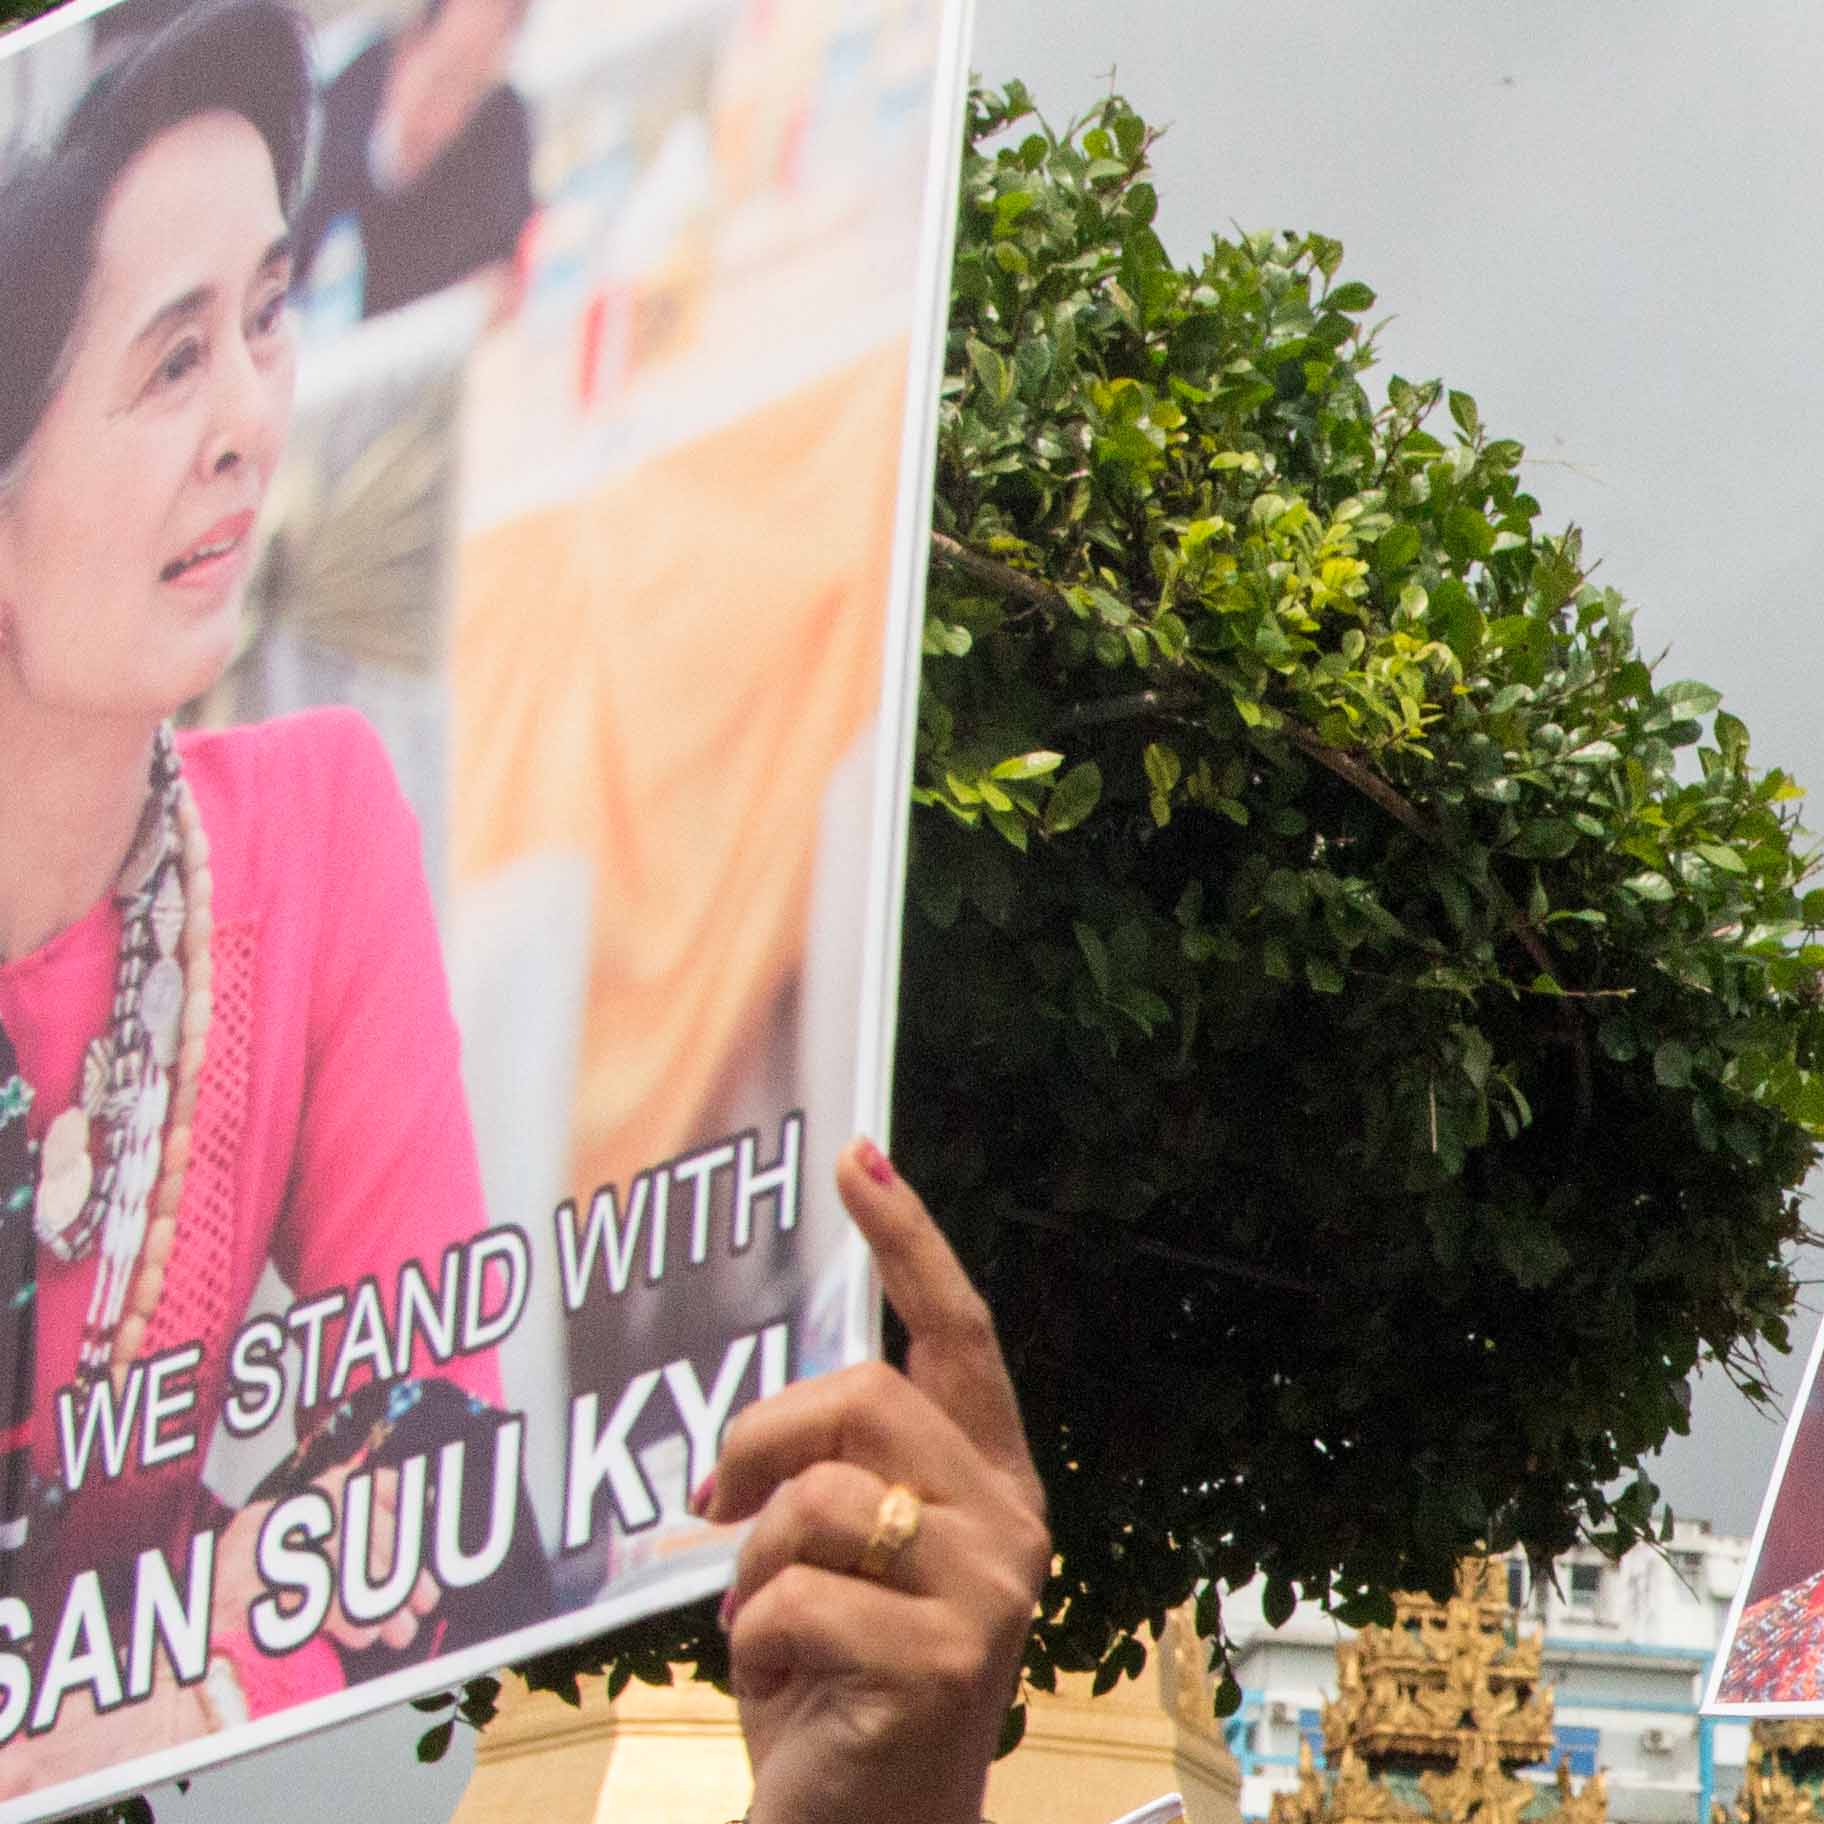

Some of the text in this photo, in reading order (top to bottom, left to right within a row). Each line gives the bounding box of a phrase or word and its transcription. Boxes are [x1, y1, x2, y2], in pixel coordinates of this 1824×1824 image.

[56, 1108, 804, 1492] WE STAND WITH
[249, 1409, 524, 1660] SUU
